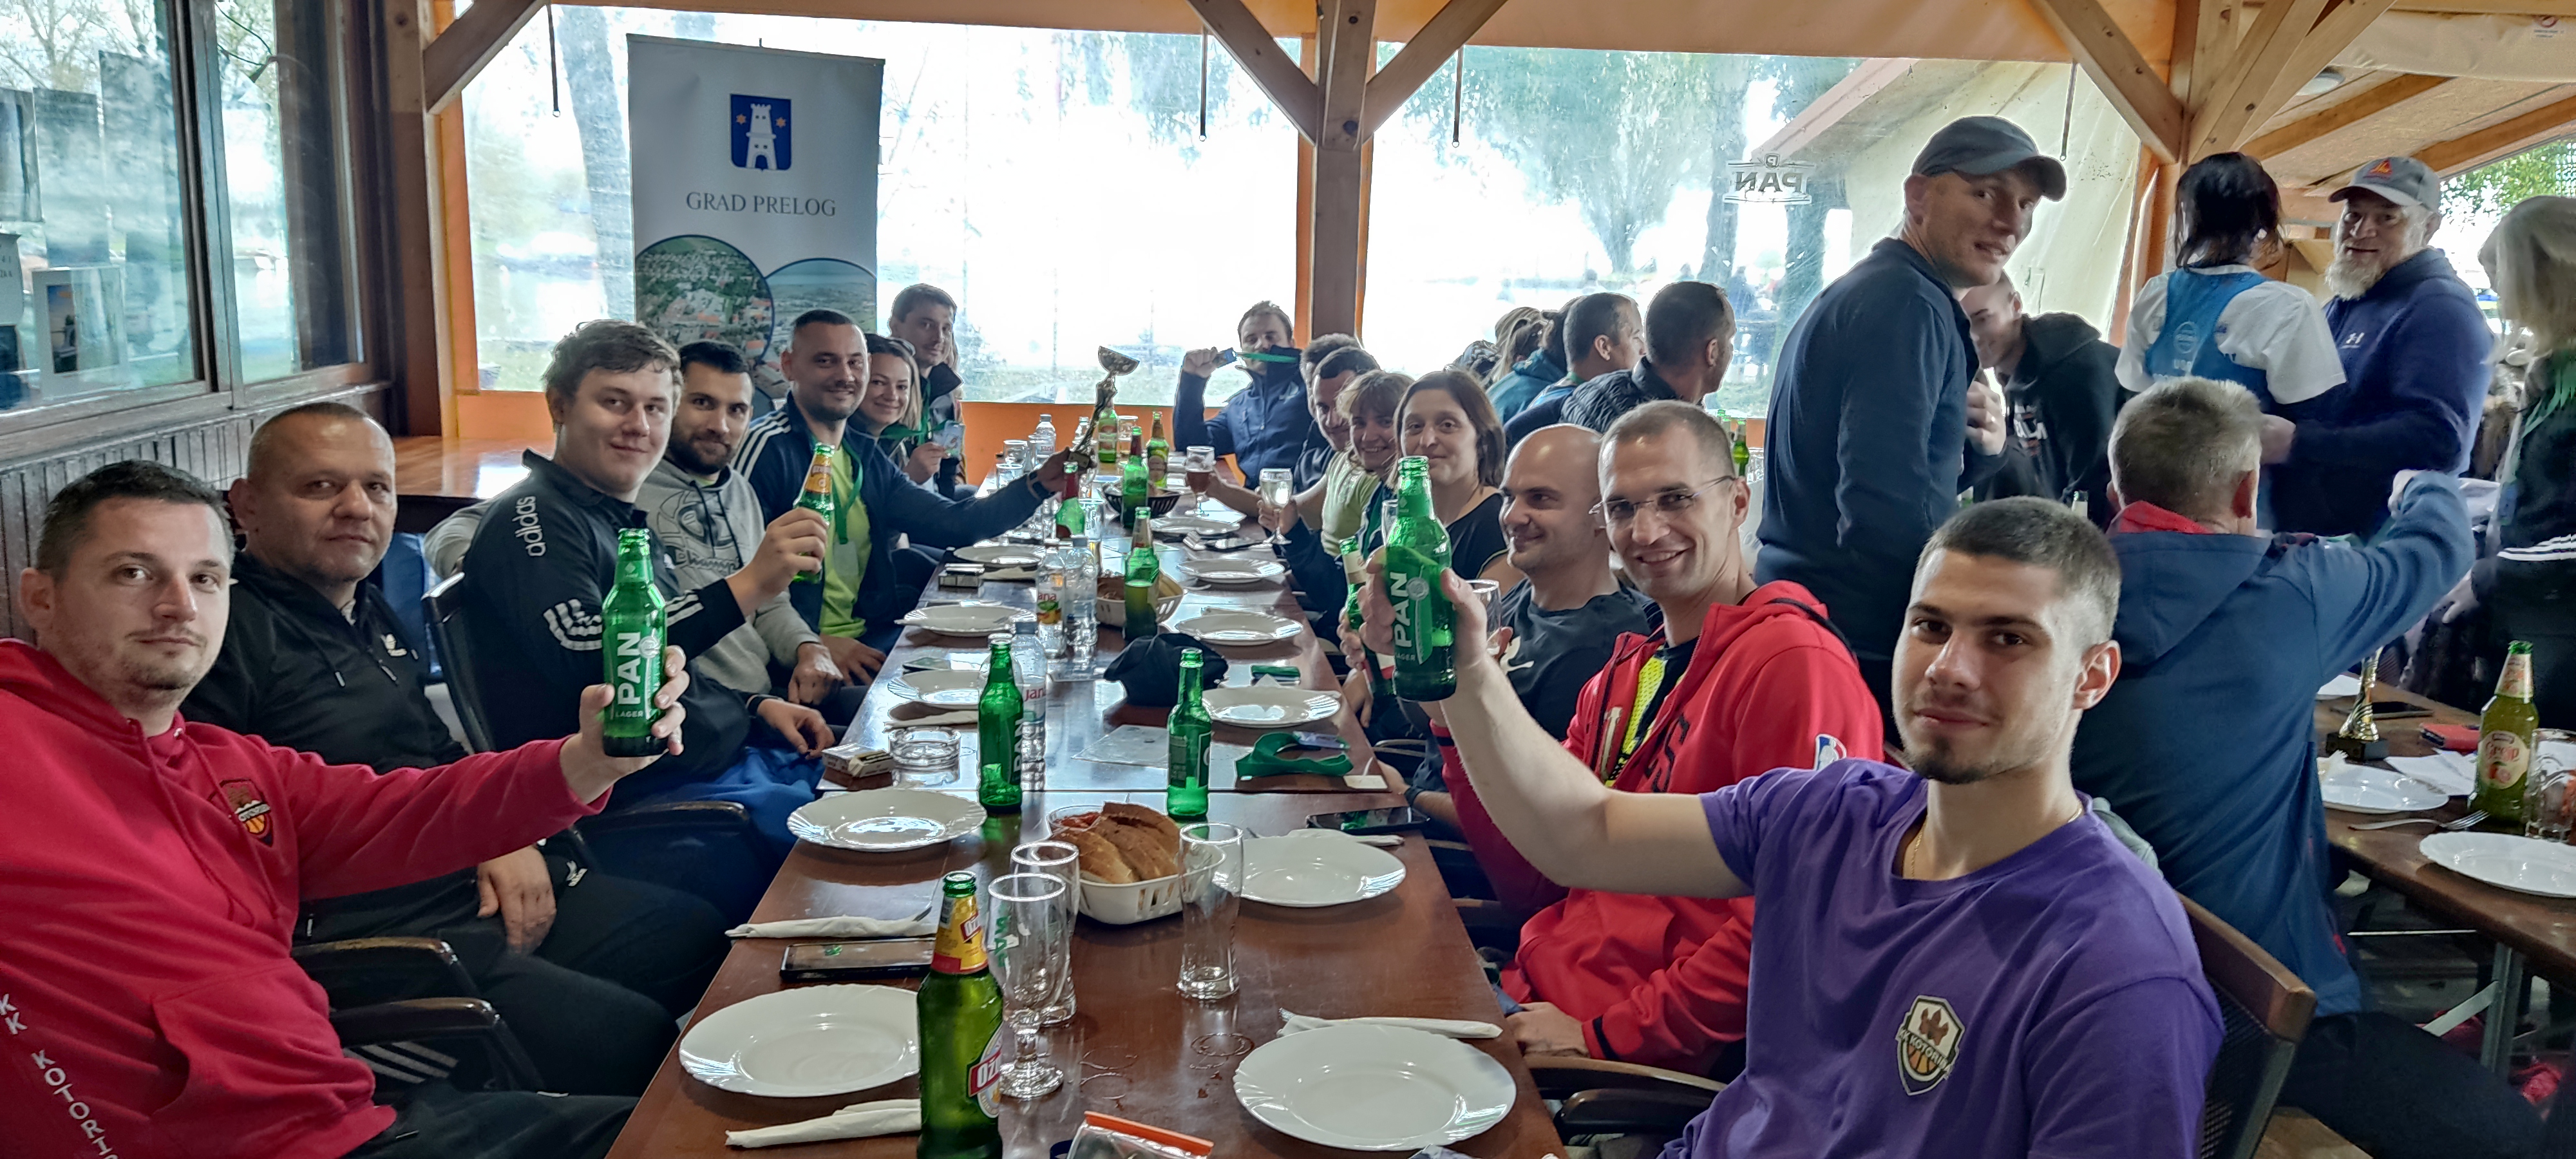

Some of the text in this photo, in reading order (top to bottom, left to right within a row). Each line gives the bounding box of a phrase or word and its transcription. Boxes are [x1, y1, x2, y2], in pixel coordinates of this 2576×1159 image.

[686, 192, 836, 217] GRAD PRELOG
[511, 496, 546, 556] adidas
[1389, 571, 1413, 648] PAN
[616, 631, 641, 705] PAN
[1025, 687, 1046, 702] Jan
[0, 994, 28, 1035] KK
